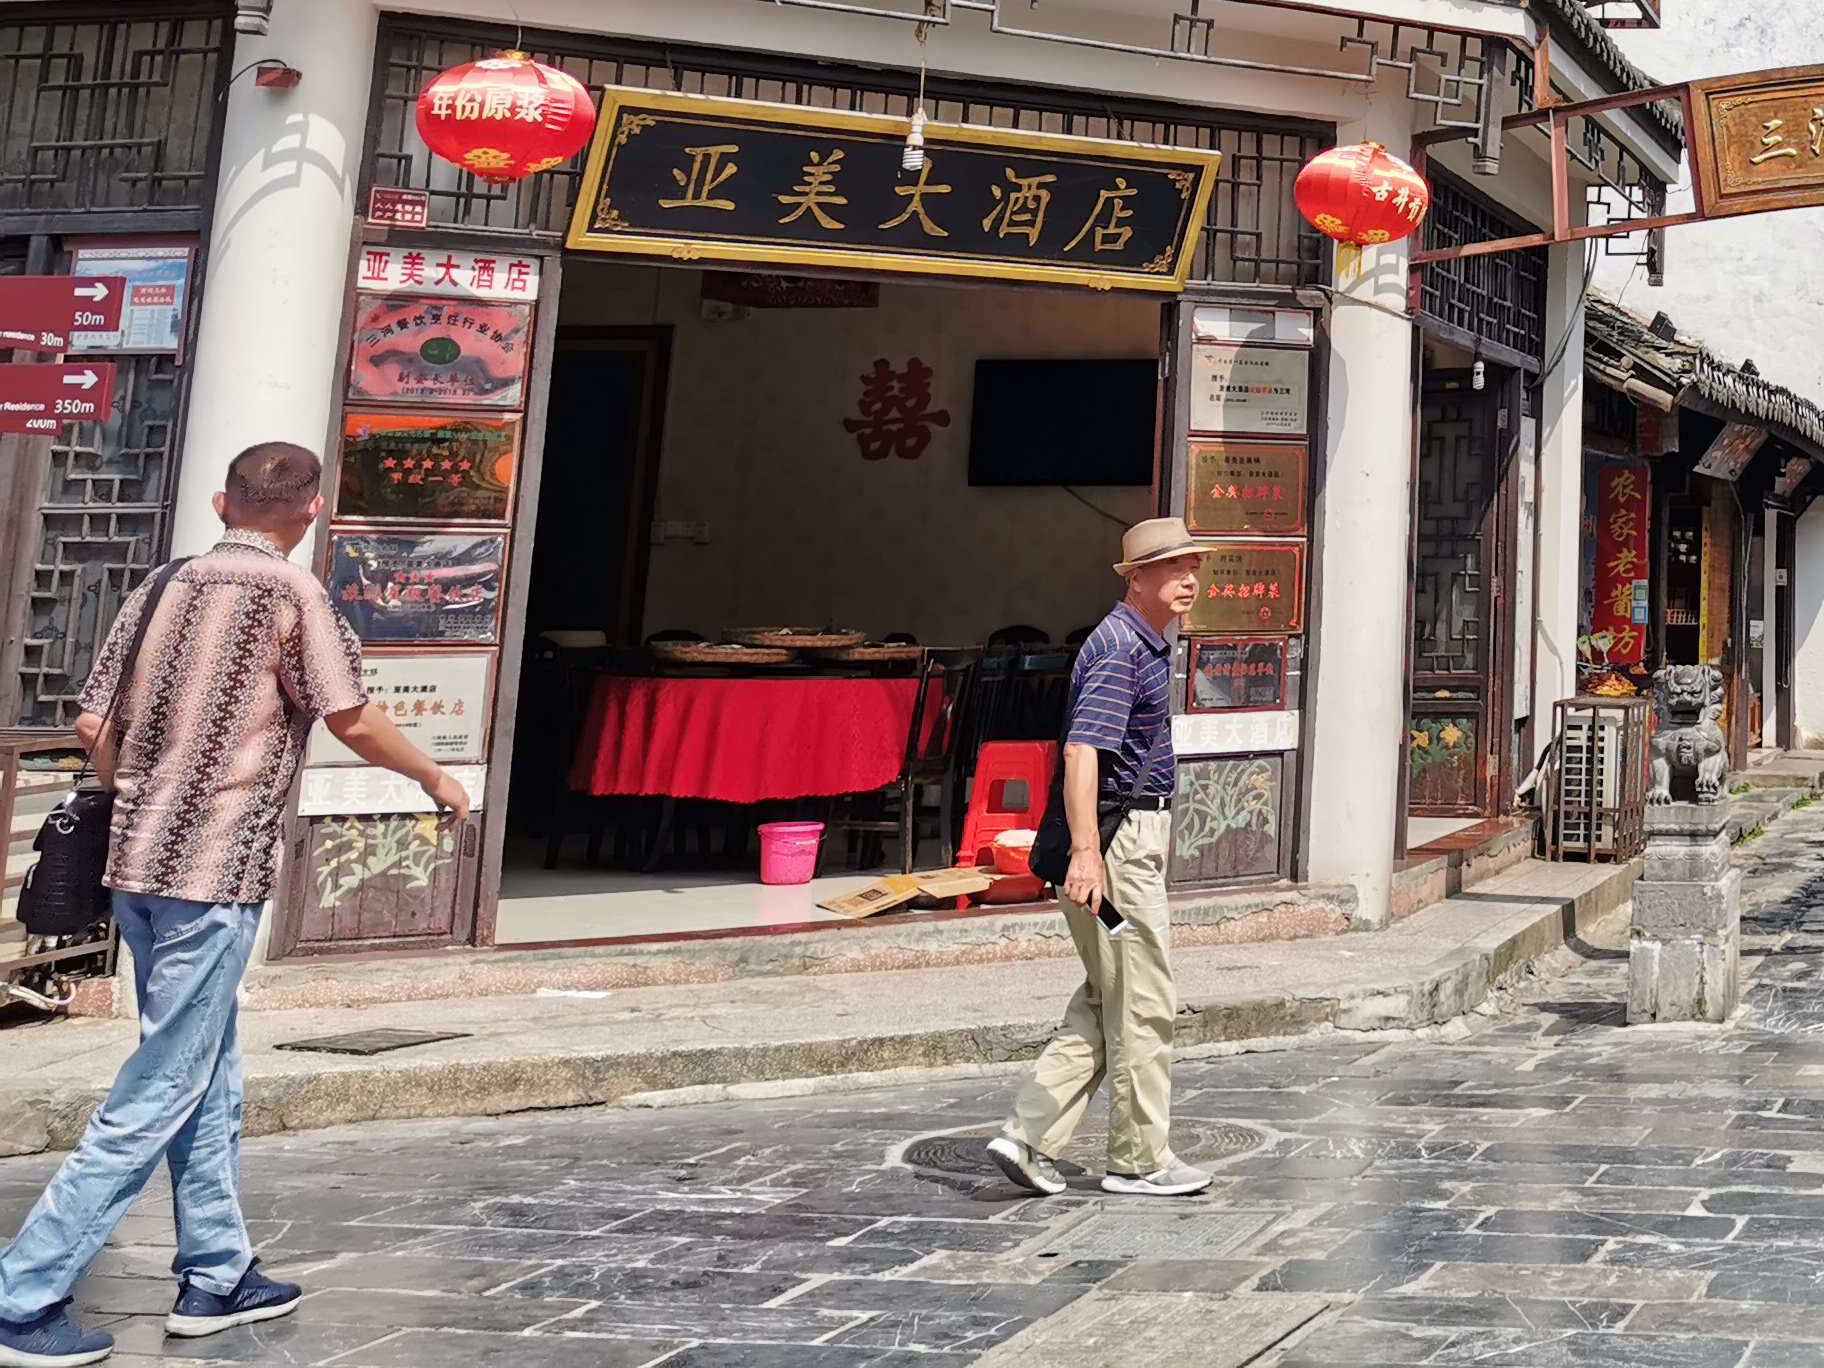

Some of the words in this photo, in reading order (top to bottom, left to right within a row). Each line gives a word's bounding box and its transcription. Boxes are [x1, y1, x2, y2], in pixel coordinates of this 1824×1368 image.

[431, 91, 545, 123] 年份原浆
[658, 143, 1141, 254] 亚美大酒店
[362, 250, 531, 293] 亚美大酒店
[73, 311, 105, 326] 50m
[40, 332, 64, 347] 30m
[3, 401, 46, 412] Residence
[54, 399, 95, 414] 350m
[1207, 582, 1280, 599] 金奖招牌菜
[304, 771, 477, 806] 亚美大店
